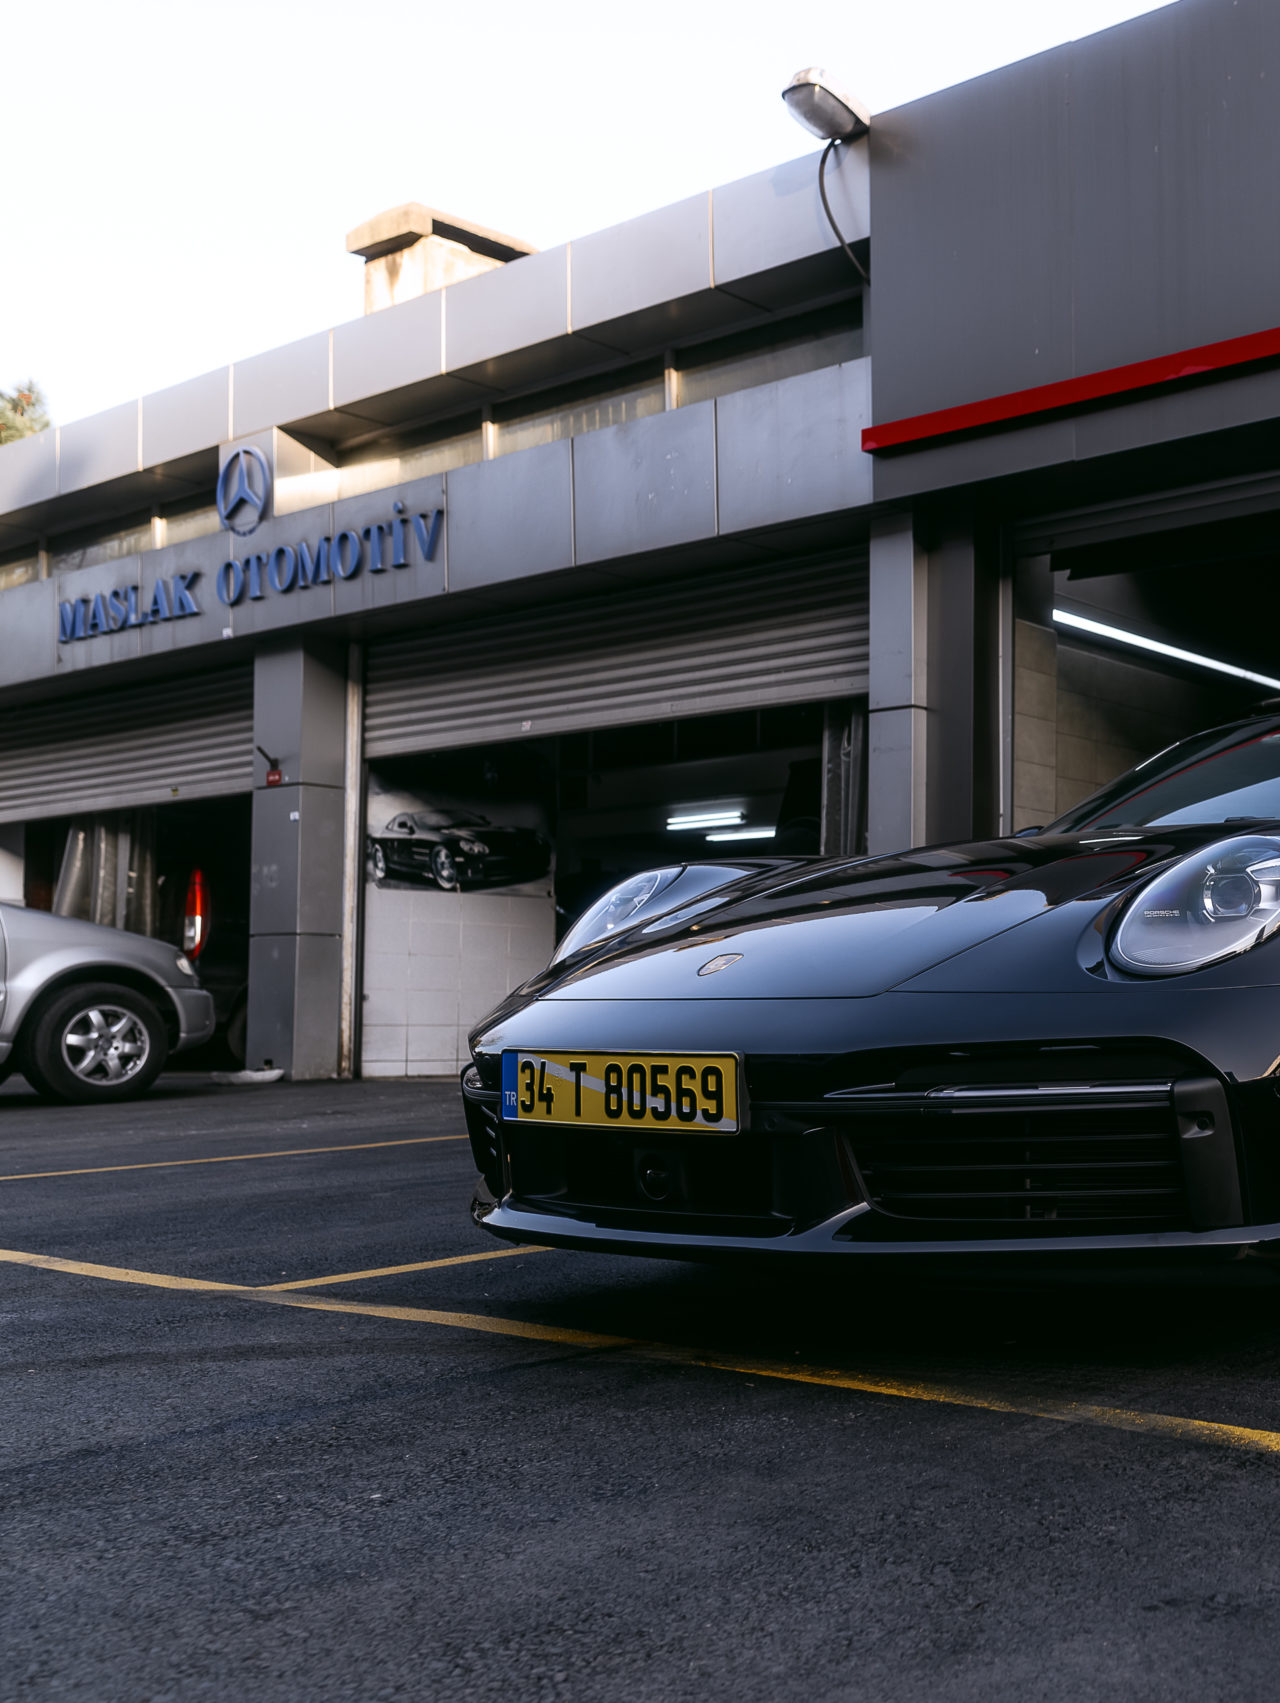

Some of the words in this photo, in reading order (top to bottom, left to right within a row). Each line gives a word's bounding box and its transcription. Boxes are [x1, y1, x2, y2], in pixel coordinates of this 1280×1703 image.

[59, 571, 201, 643] MASLAK
[504, 1090, 517, 1107] TR
[520, 1059, 555, 1116] 34
[569, 1061, 588, 1117] T
[604, 1062, 724, 1124] 80569
